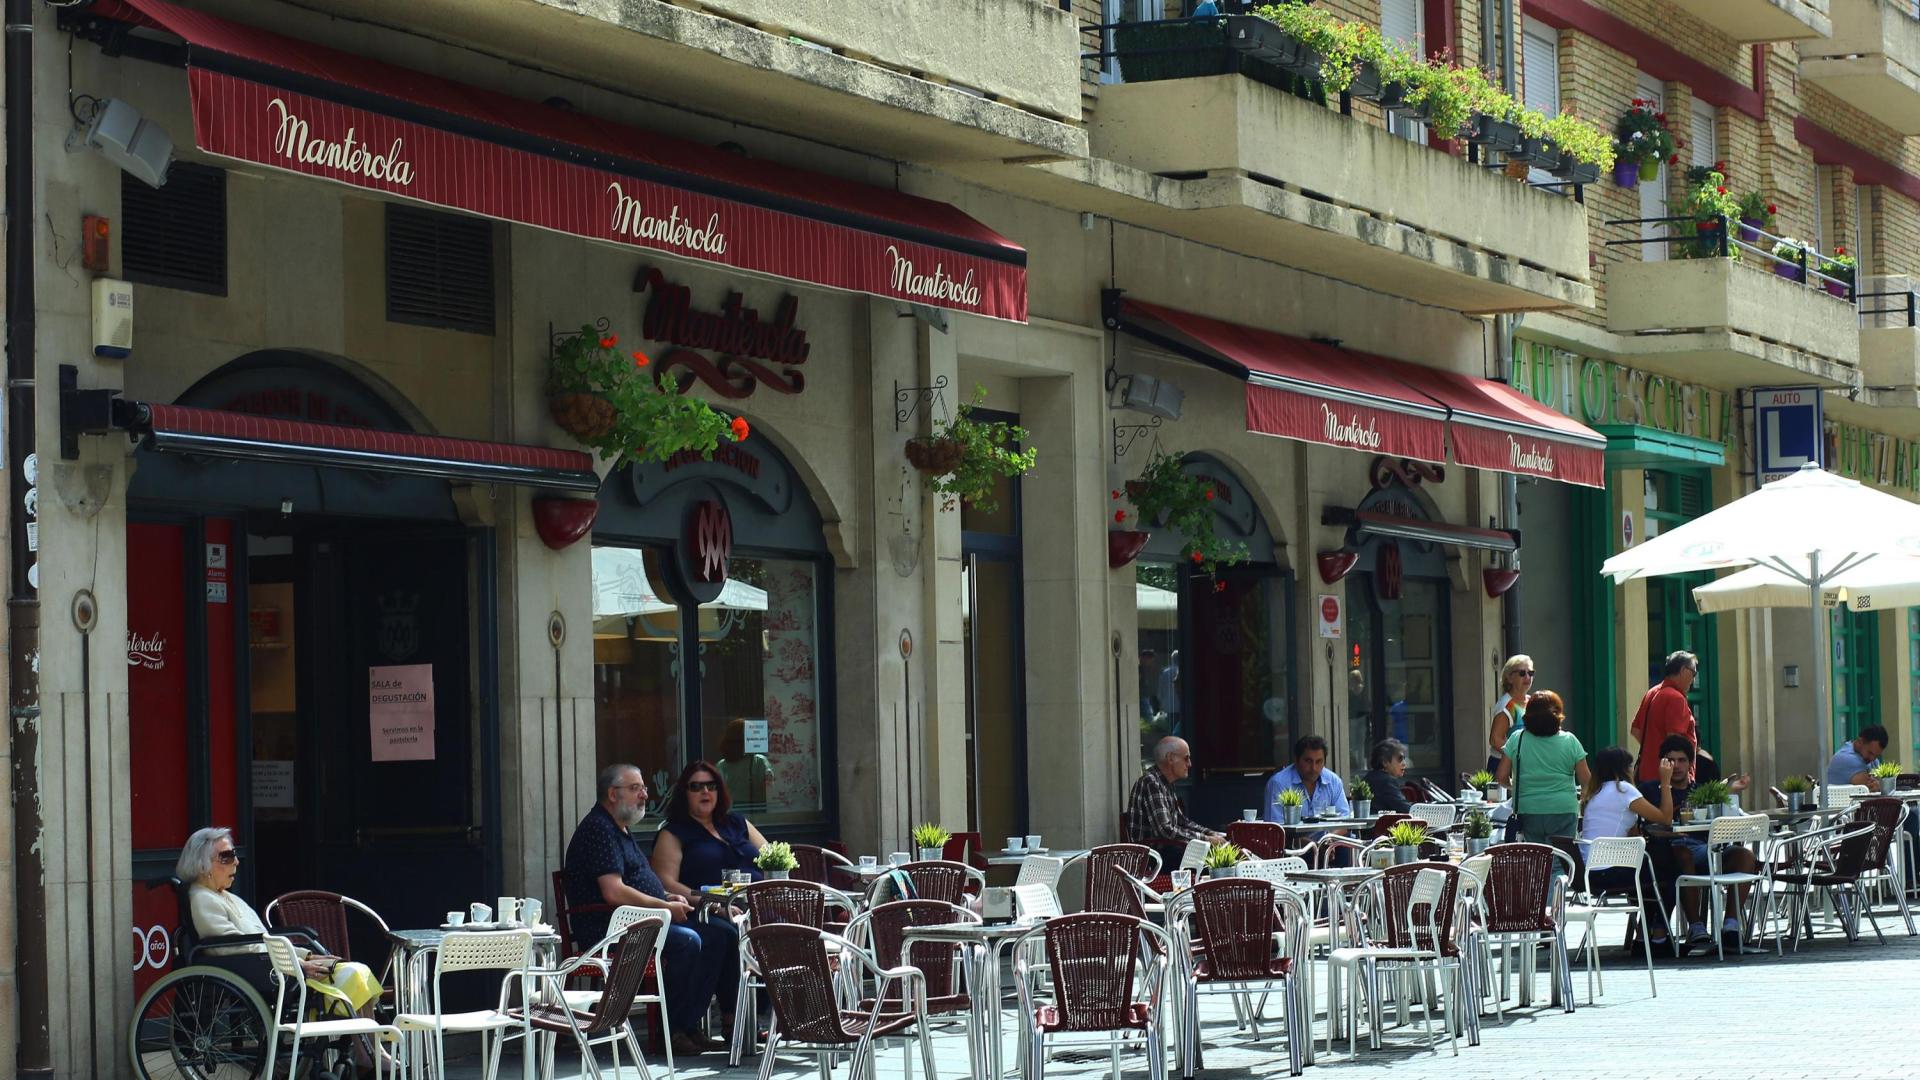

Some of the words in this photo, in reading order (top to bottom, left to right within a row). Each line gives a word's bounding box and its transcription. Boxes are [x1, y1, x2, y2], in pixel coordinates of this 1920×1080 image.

[266, 98, 415, 186] Manterola
[607, 182, 727, 255] Manterola
[885, 245, 982, 306] Manterola
[1772, 392, 1801, 405] AUTO
[1320, 402, 1382, 448] Manterola
[1767, 410, 1809, 469] L
[1506, 433, 1555, 474] Manterola
[372, 691, 427, 702] DEGUSTACIÓN
[392, 680, 402, 688] de
[149, 940, 166, 951] años
